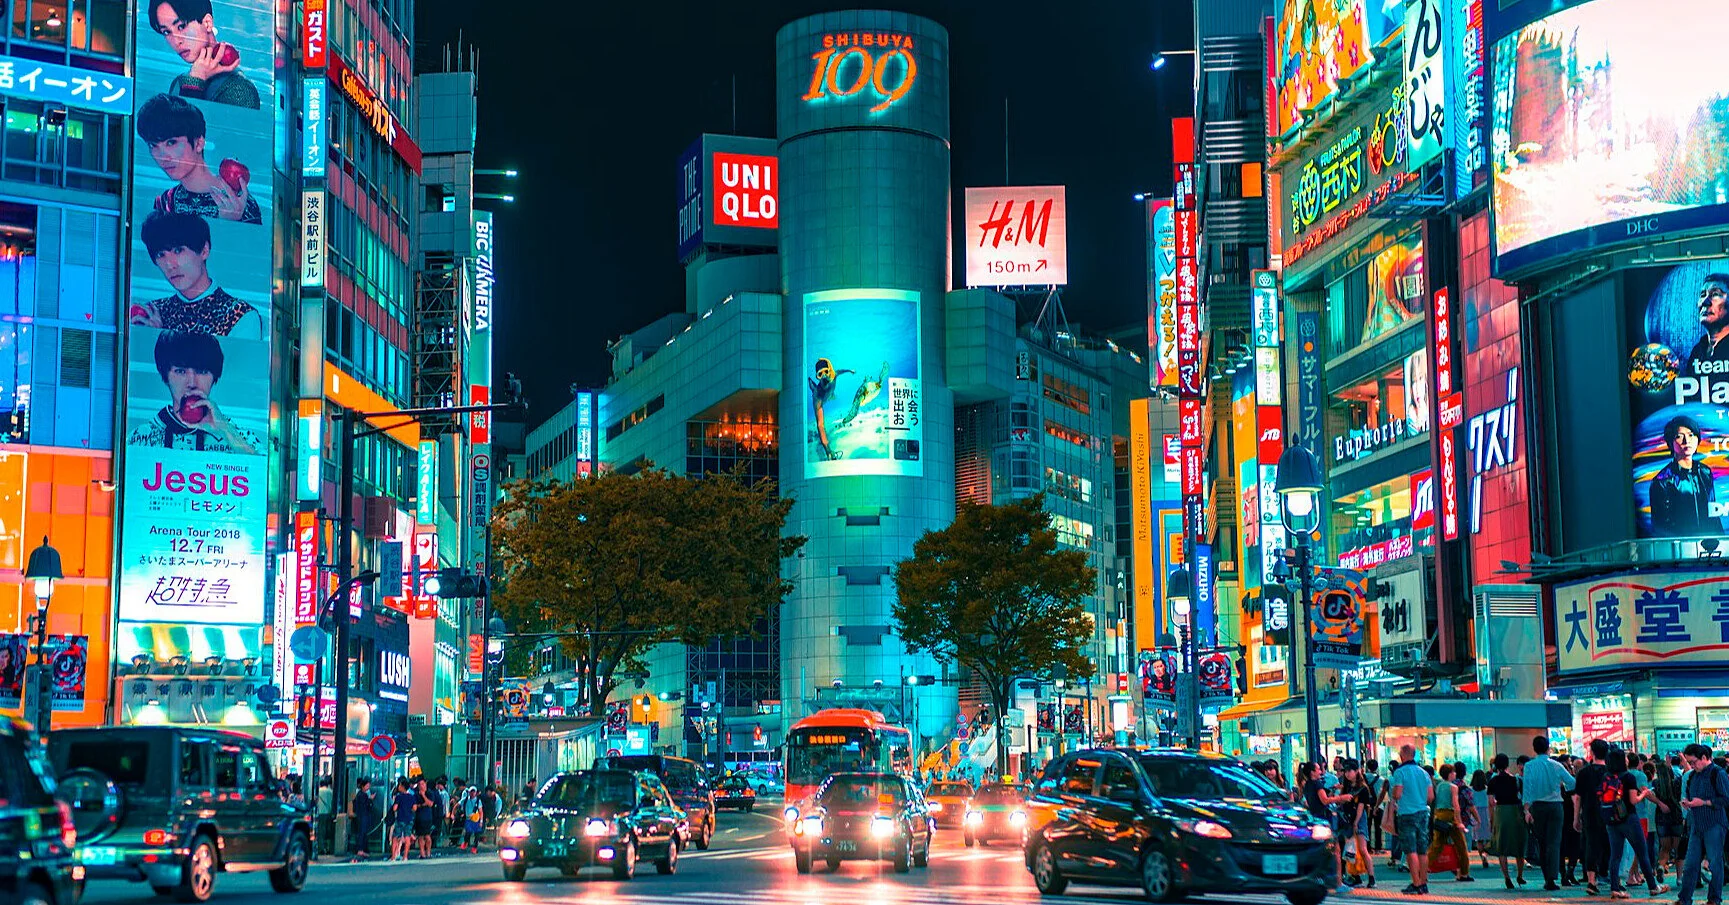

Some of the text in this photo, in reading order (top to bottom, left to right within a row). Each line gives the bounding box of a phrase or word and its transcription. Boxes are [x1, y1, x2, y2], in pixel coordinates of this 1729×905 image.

[308, 11, 322, 58] ガスト
[823, 34, 913, 48] SHIBUYA
[802, 47, 917, 112] 109
[308, 88, 321, 167] 英会話イーオン
[684, 156, 696, 201] THE
[722, 162, 770, 190] UNI
[1321, 145, 1362, 214] 西村
[722, 192, 776, 221] QLO
[979, 199, 1053, 248] H&M
[306, 197, 320, 279] 渋谷駅前ビル
[1627, 218, 1659, 235] DHC
[475, 221, 495, 331] BIC CAMERA
[987, 261, 1031, 274] 150m
[1437, 295, 1450, 392] お好み焼
[893, 388, 918, 399] 世界に
[1260, 428, 1281, 442] JTB
[1335, 414, 1404, 460] Euphoria
[143, 462, 249, 497] Jesus
[224, 465, 249, 473] SINGLE
[473, 454, 490, 480] OS
[150, 525, 240, 540] Arena Tour 2018
[169, 539, 225, 555] 12.7 FRI
[138, 555, 249, 570] さいたまスーパーアリーナ
[299, 542, 313, 615] サンドラッグ
[1197, 556, 1209, 602] MIZUHO
[1269, 597, 1288, 630] HUB
[381, 650, 410, 689] LUSH
[1572, 686, 1598, 694] TAISEIDO
